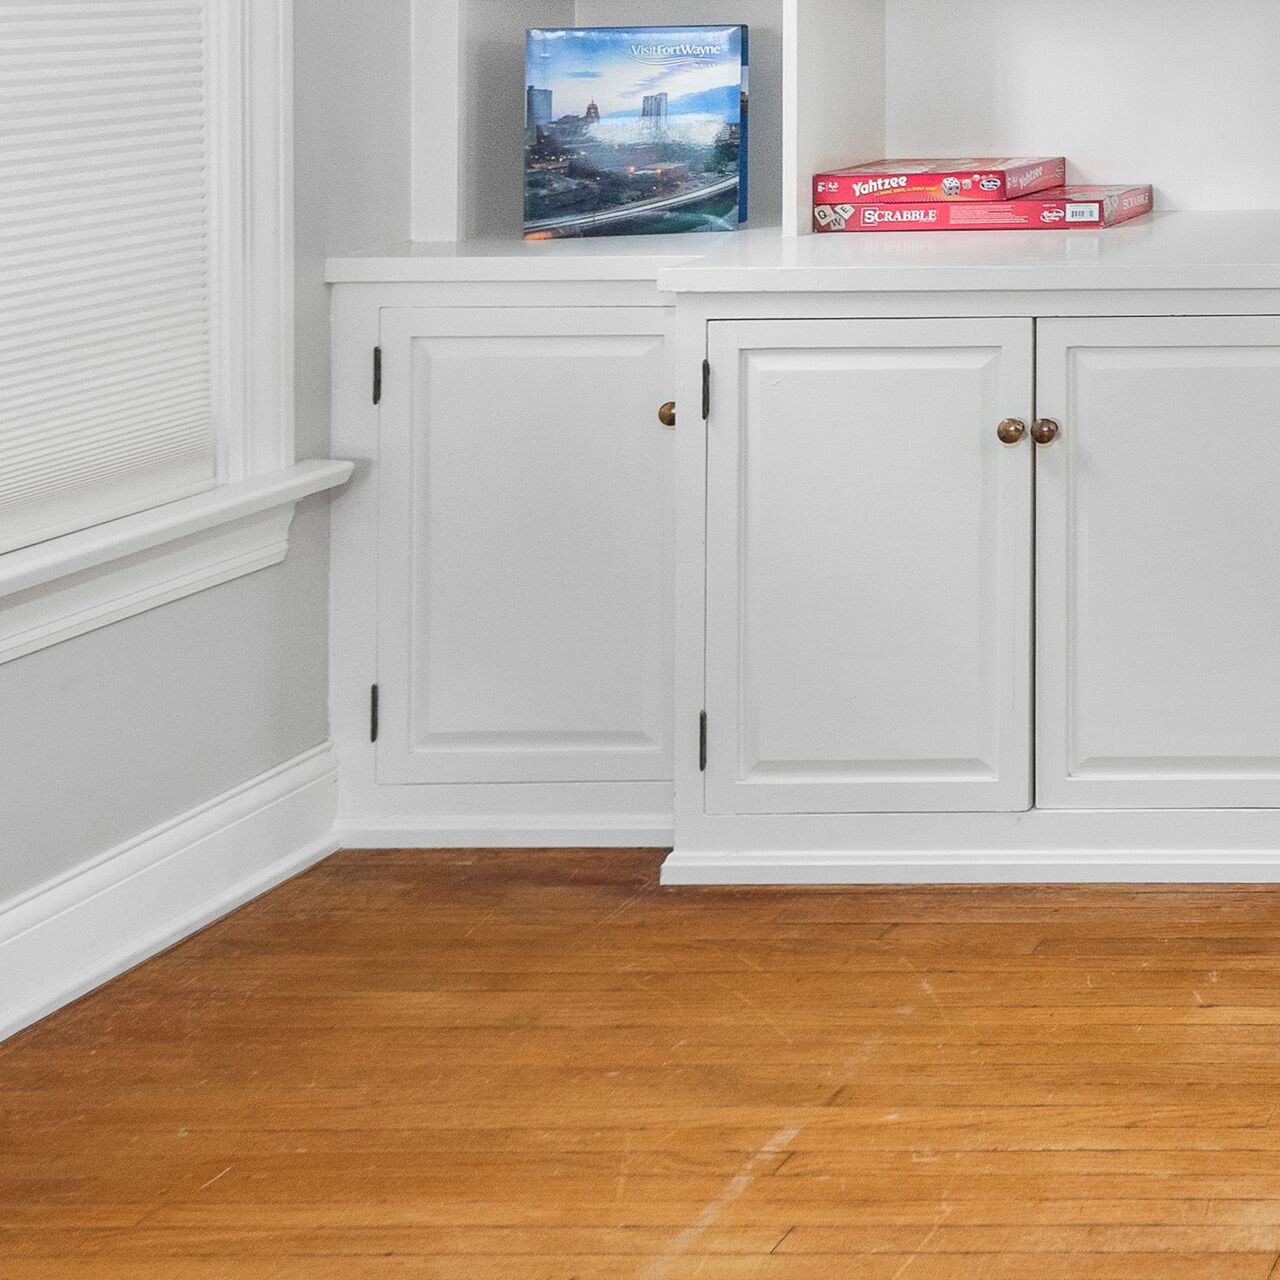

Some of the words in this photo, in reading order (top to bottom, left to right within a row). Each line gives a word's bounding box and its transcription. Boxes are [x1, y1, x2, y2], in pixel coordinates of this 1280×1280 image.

[852, 176, 908, 197] Yahtzee
[818, 210, 828, 220] Q
[864, 209, 937, 223] SCRABBLE
